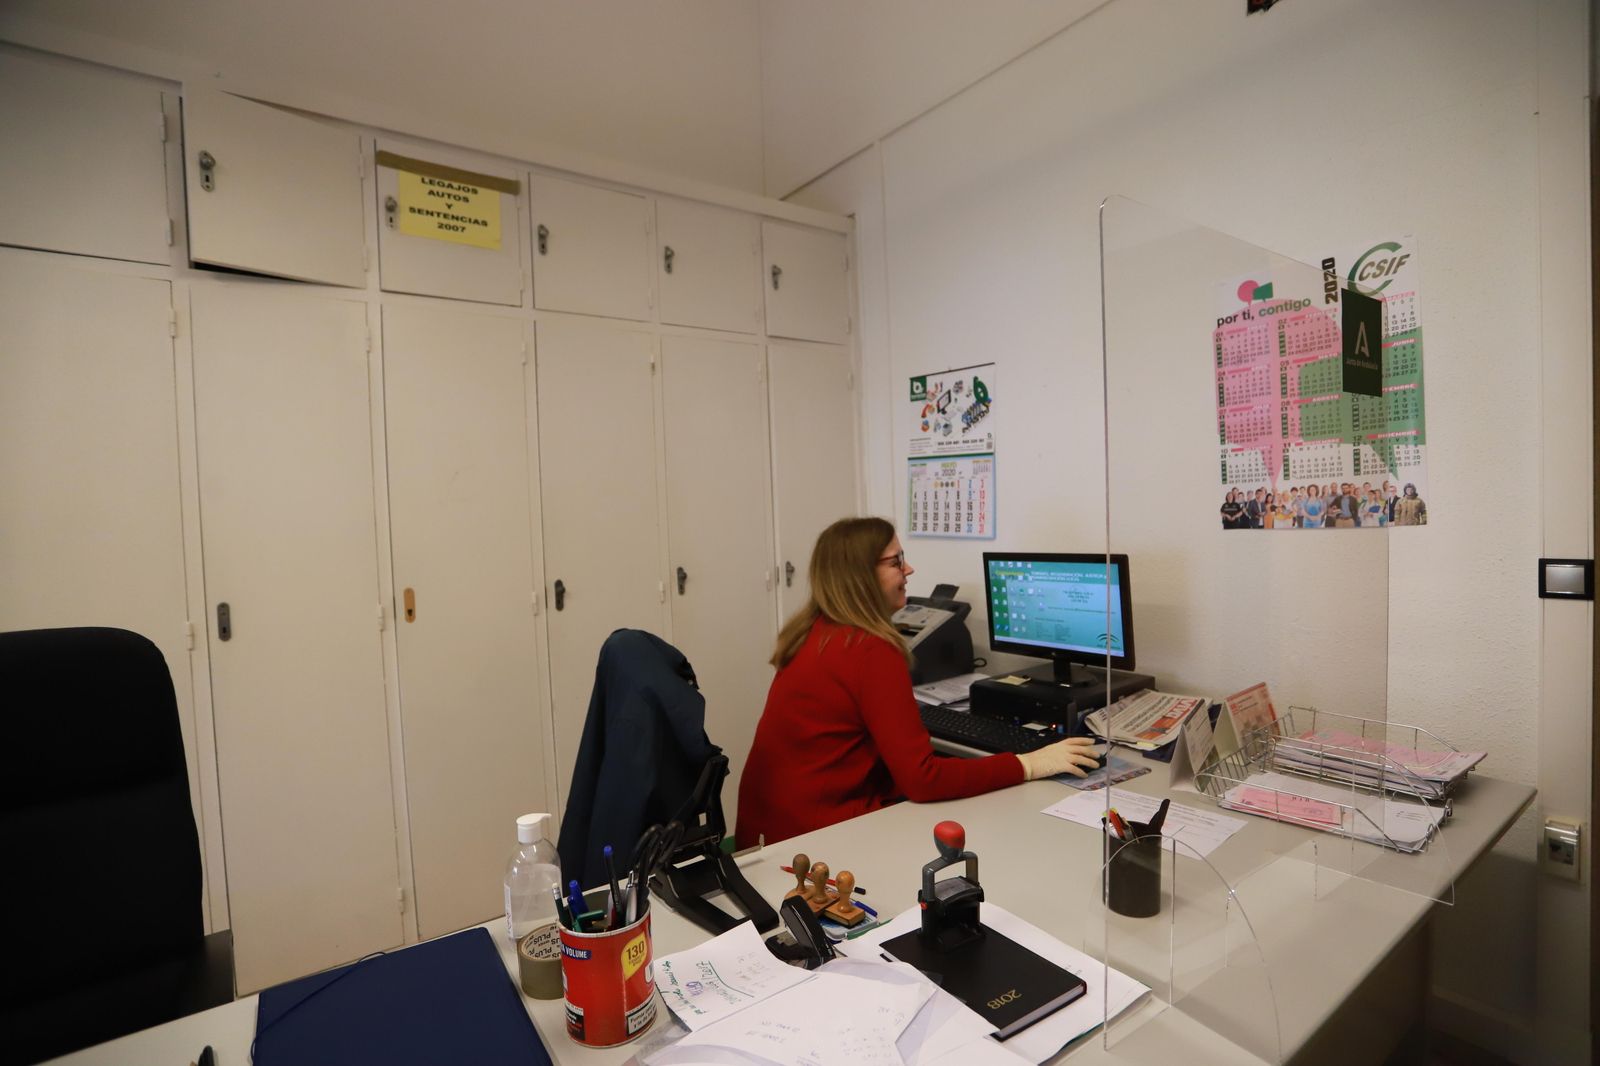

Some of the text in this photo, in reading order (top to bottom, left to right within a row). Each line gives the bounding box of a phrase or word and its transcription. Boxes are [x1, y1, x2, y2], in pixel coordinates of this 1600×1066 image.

[421, 177, 479, 195] LEGAJOS
[428, 189, 469, 203] AUTOS
[409, 206, 488, 227] SENTENCIAS
[437, 222, 466, 232] 2007
[1358, 253, 1411, 282] CSIF
[1322, 257, 1339, 304] 2020
[1216, 314, 1239, 327] por
[1242, 309, 1255, 320] ti,
[1258, 298, 1311, 317] contigo
[534, 932, 551, 945] PLUS
[534, 947, 552, 957] PLUS
[566, 946, 588, 958] VOLUME
[626, 942, 644, 960] 130
[986, 988, 1023, 1010] 2018
